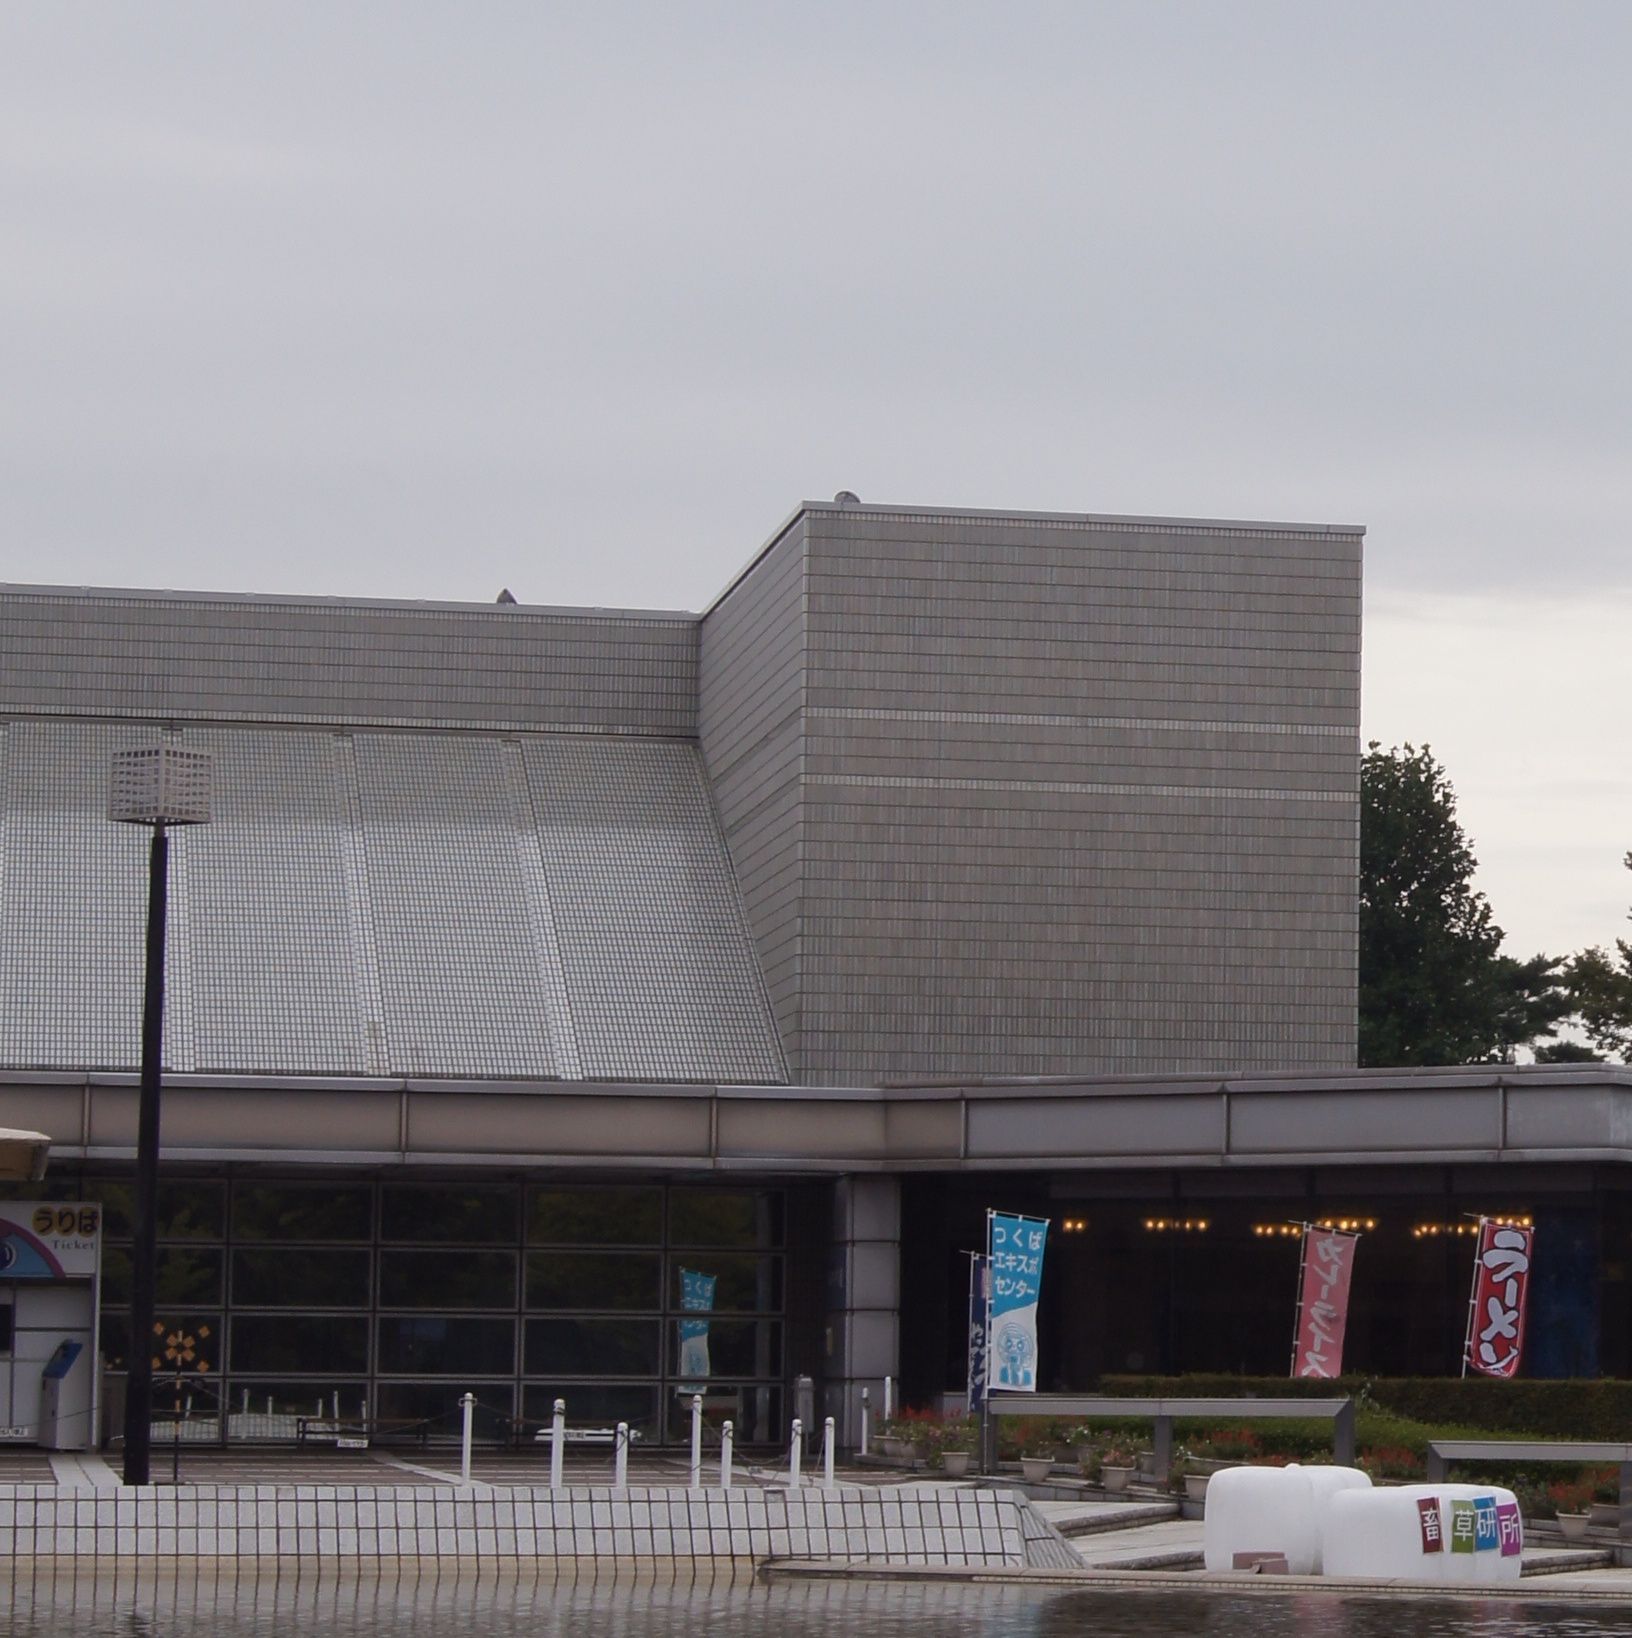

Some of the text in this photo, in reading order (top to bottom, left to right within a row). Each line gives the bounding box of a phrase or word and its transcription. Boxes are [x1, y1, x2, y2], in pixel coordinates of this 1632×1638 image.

[52, 1239, 95, 1250] Ticket
[994, 1227, 1043, 1250] つくば
[994, 1276, 1036, 1298] センター
[1476, 1229, 1529, 1370] ラーメン
